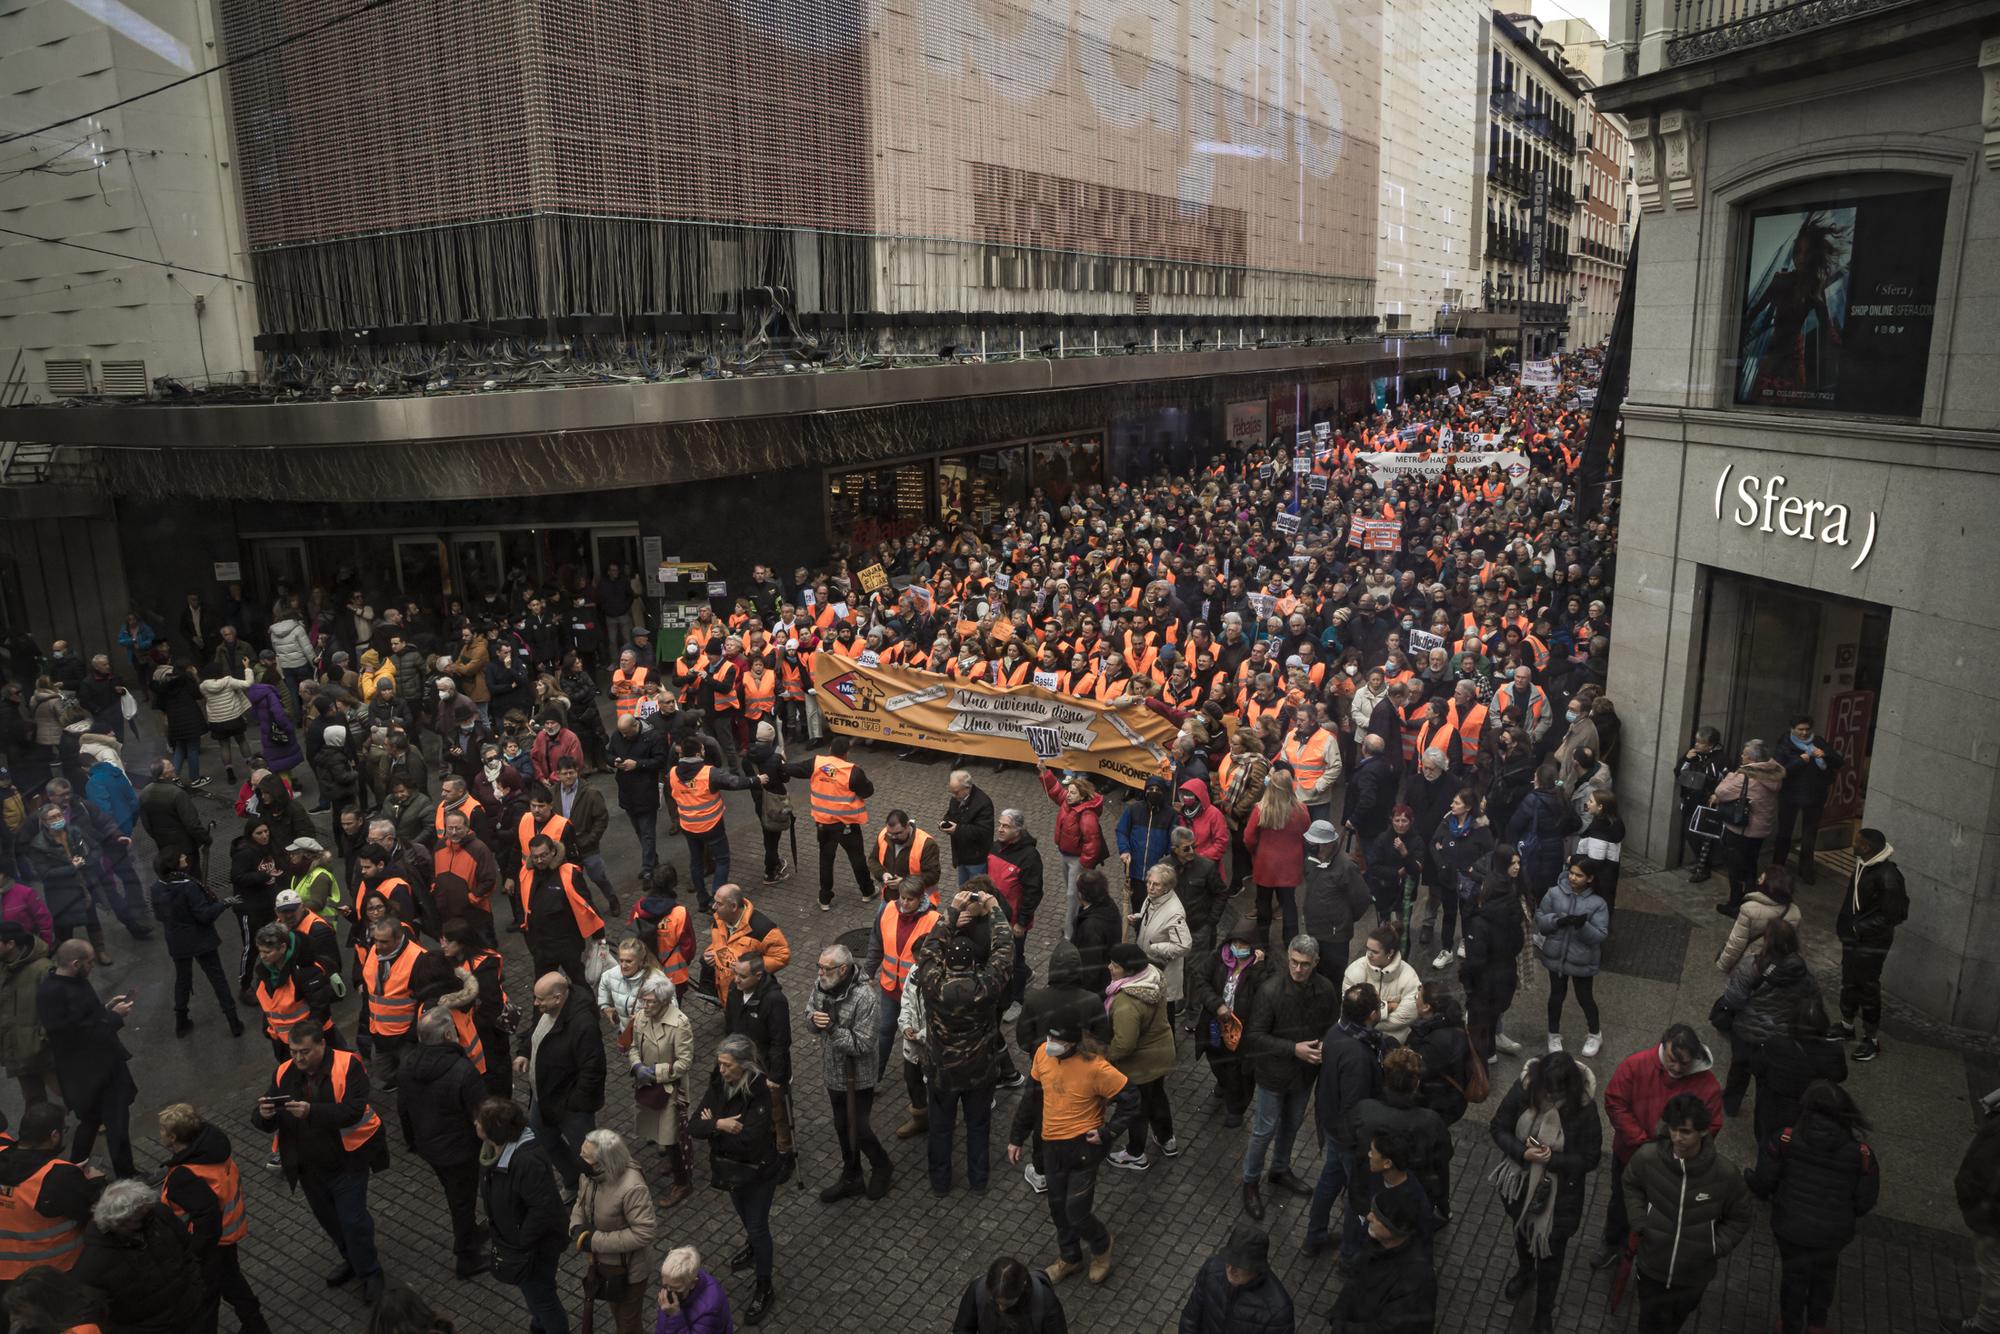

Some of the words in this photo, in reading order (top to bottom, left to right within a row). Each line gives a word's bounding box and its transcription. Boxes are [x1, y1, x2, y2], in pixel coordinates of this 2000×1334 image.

[1850, 304, 1869, 317] SHOP
[1869, 304, 1894, 317] ONLINE
[957, 689, 990, 710] Una
[993, 698, 1049, 716] vivienda
[825, 716, 860, 728] METRO
[861, 720, 882, 732] L7B
[959, 712, 994, 731] Una
[1836, 696, 1865, 733] RE
